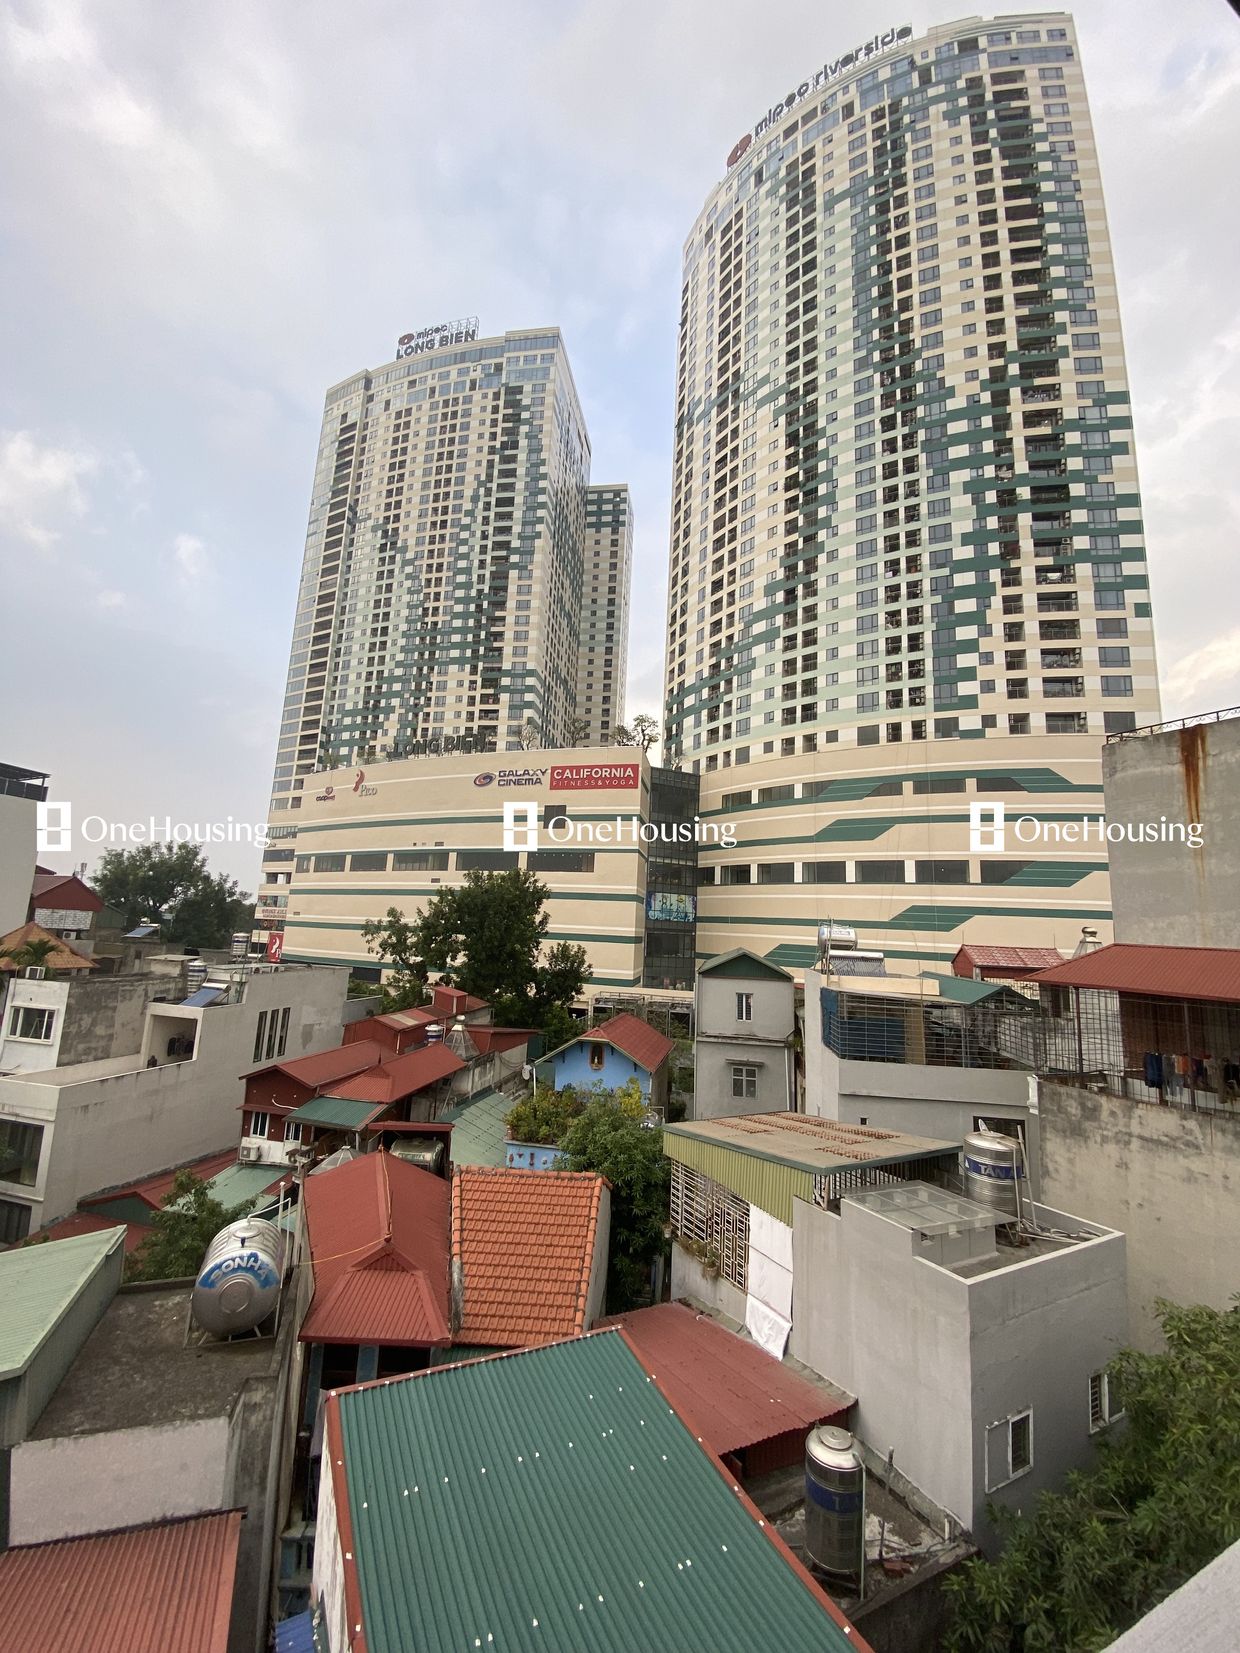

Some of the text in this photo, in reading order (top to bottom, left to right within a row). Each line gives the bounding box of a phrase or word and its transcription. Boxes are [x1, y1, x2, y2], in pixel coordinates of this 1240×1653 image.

[815, 26, 912, 86] riverside
[396, 329, 476, 360] LONG BIEN
[392, 737, 440, 758] LONG
[498, 768, 548, 778] GALAXY
[553, 767, 634, 780] CALIFORNIA
[498, 777, 543, 787] CINEMA
